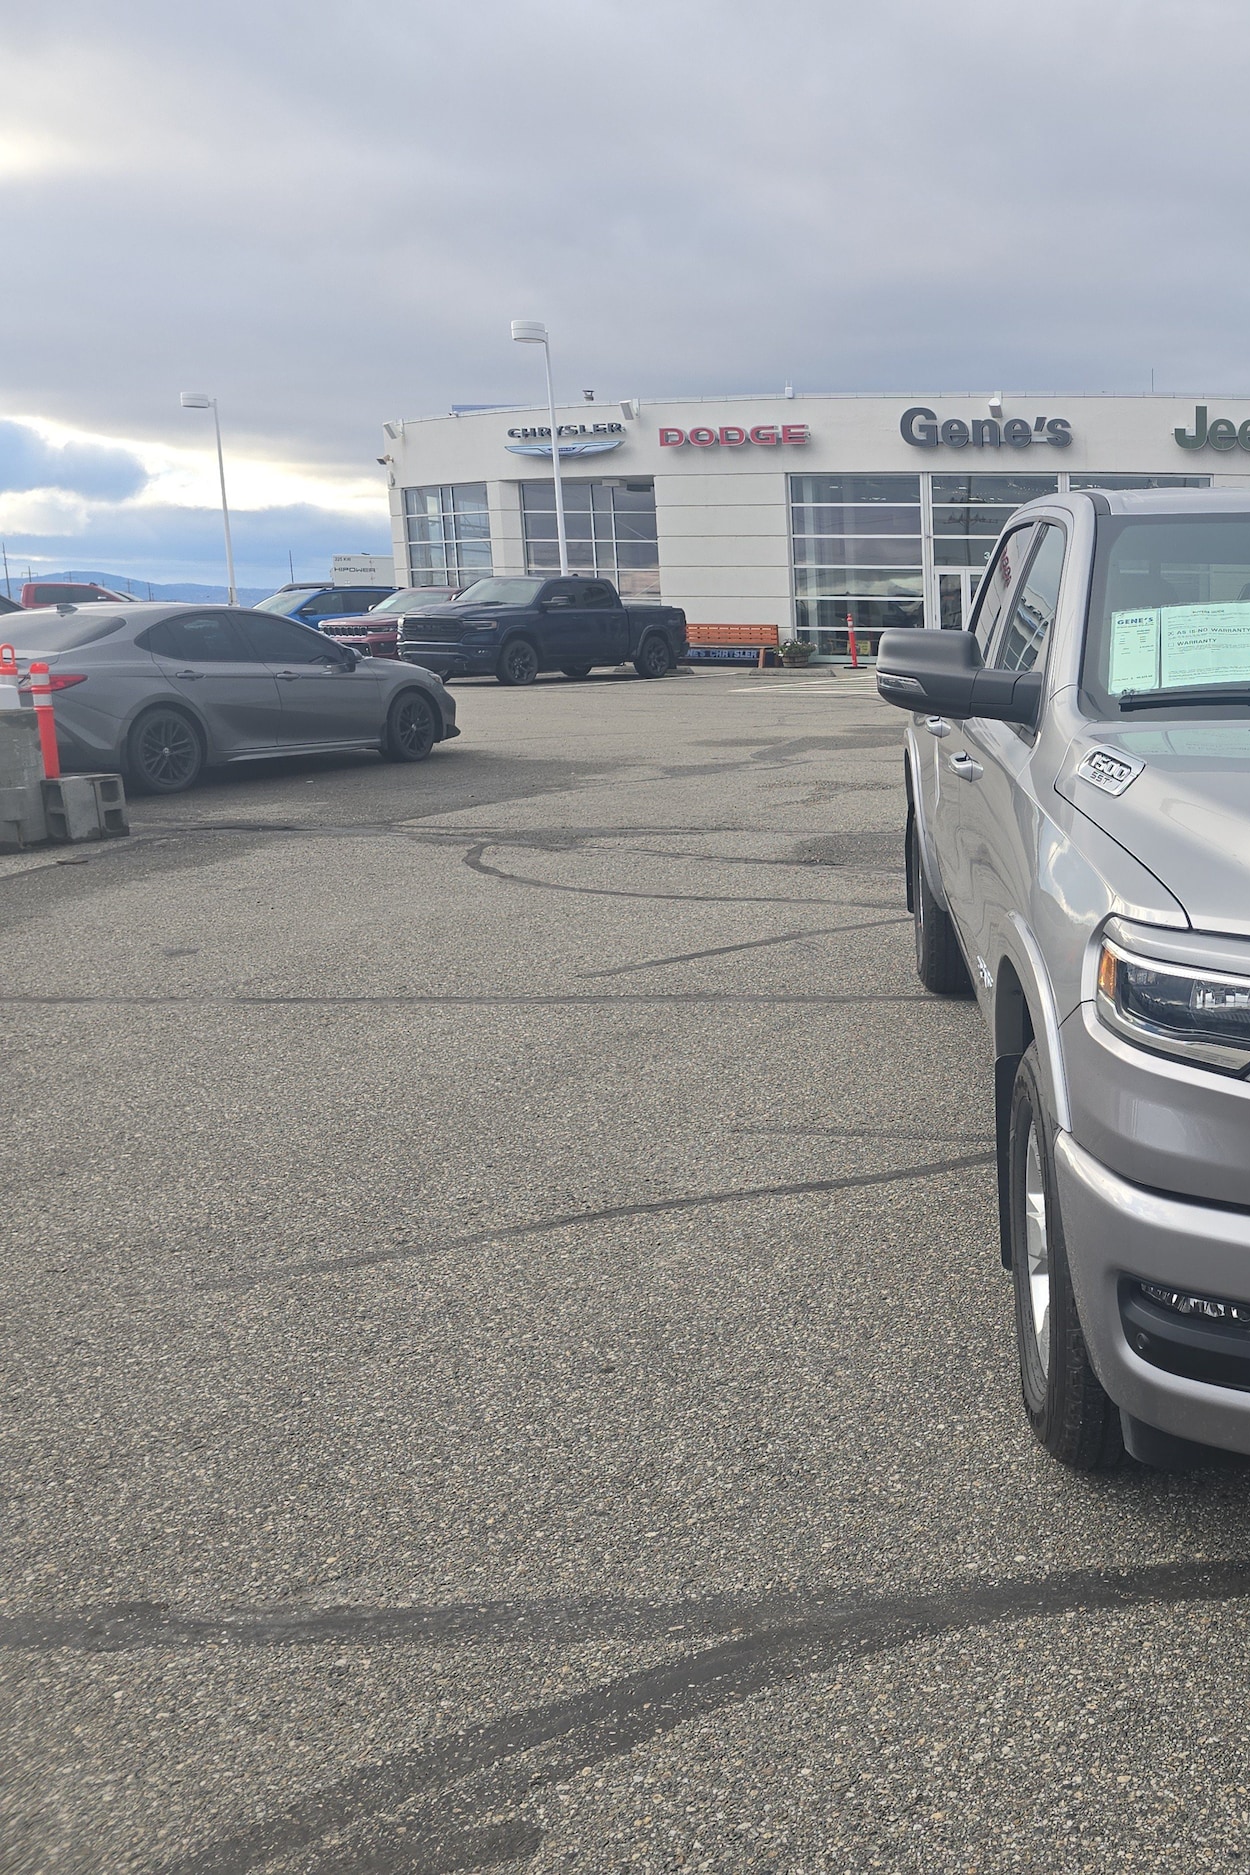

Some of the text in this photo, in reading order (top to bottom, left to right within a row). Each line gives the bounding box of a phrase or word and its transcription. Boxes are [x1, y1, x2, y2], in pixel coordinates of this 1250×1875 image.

[507, 422, 626, 438] CHRYSLER
[659, 424, 810, 447] DODGE
[900, 407, 1072, 448] Gene's
[1117, 617, 1154, 625] GENE'S
[1177, 638, 1217, 646] WARRANTY
[709, 649, 757, 658] CHRYSLER
[1091, 753, 1130, 781] 1500
